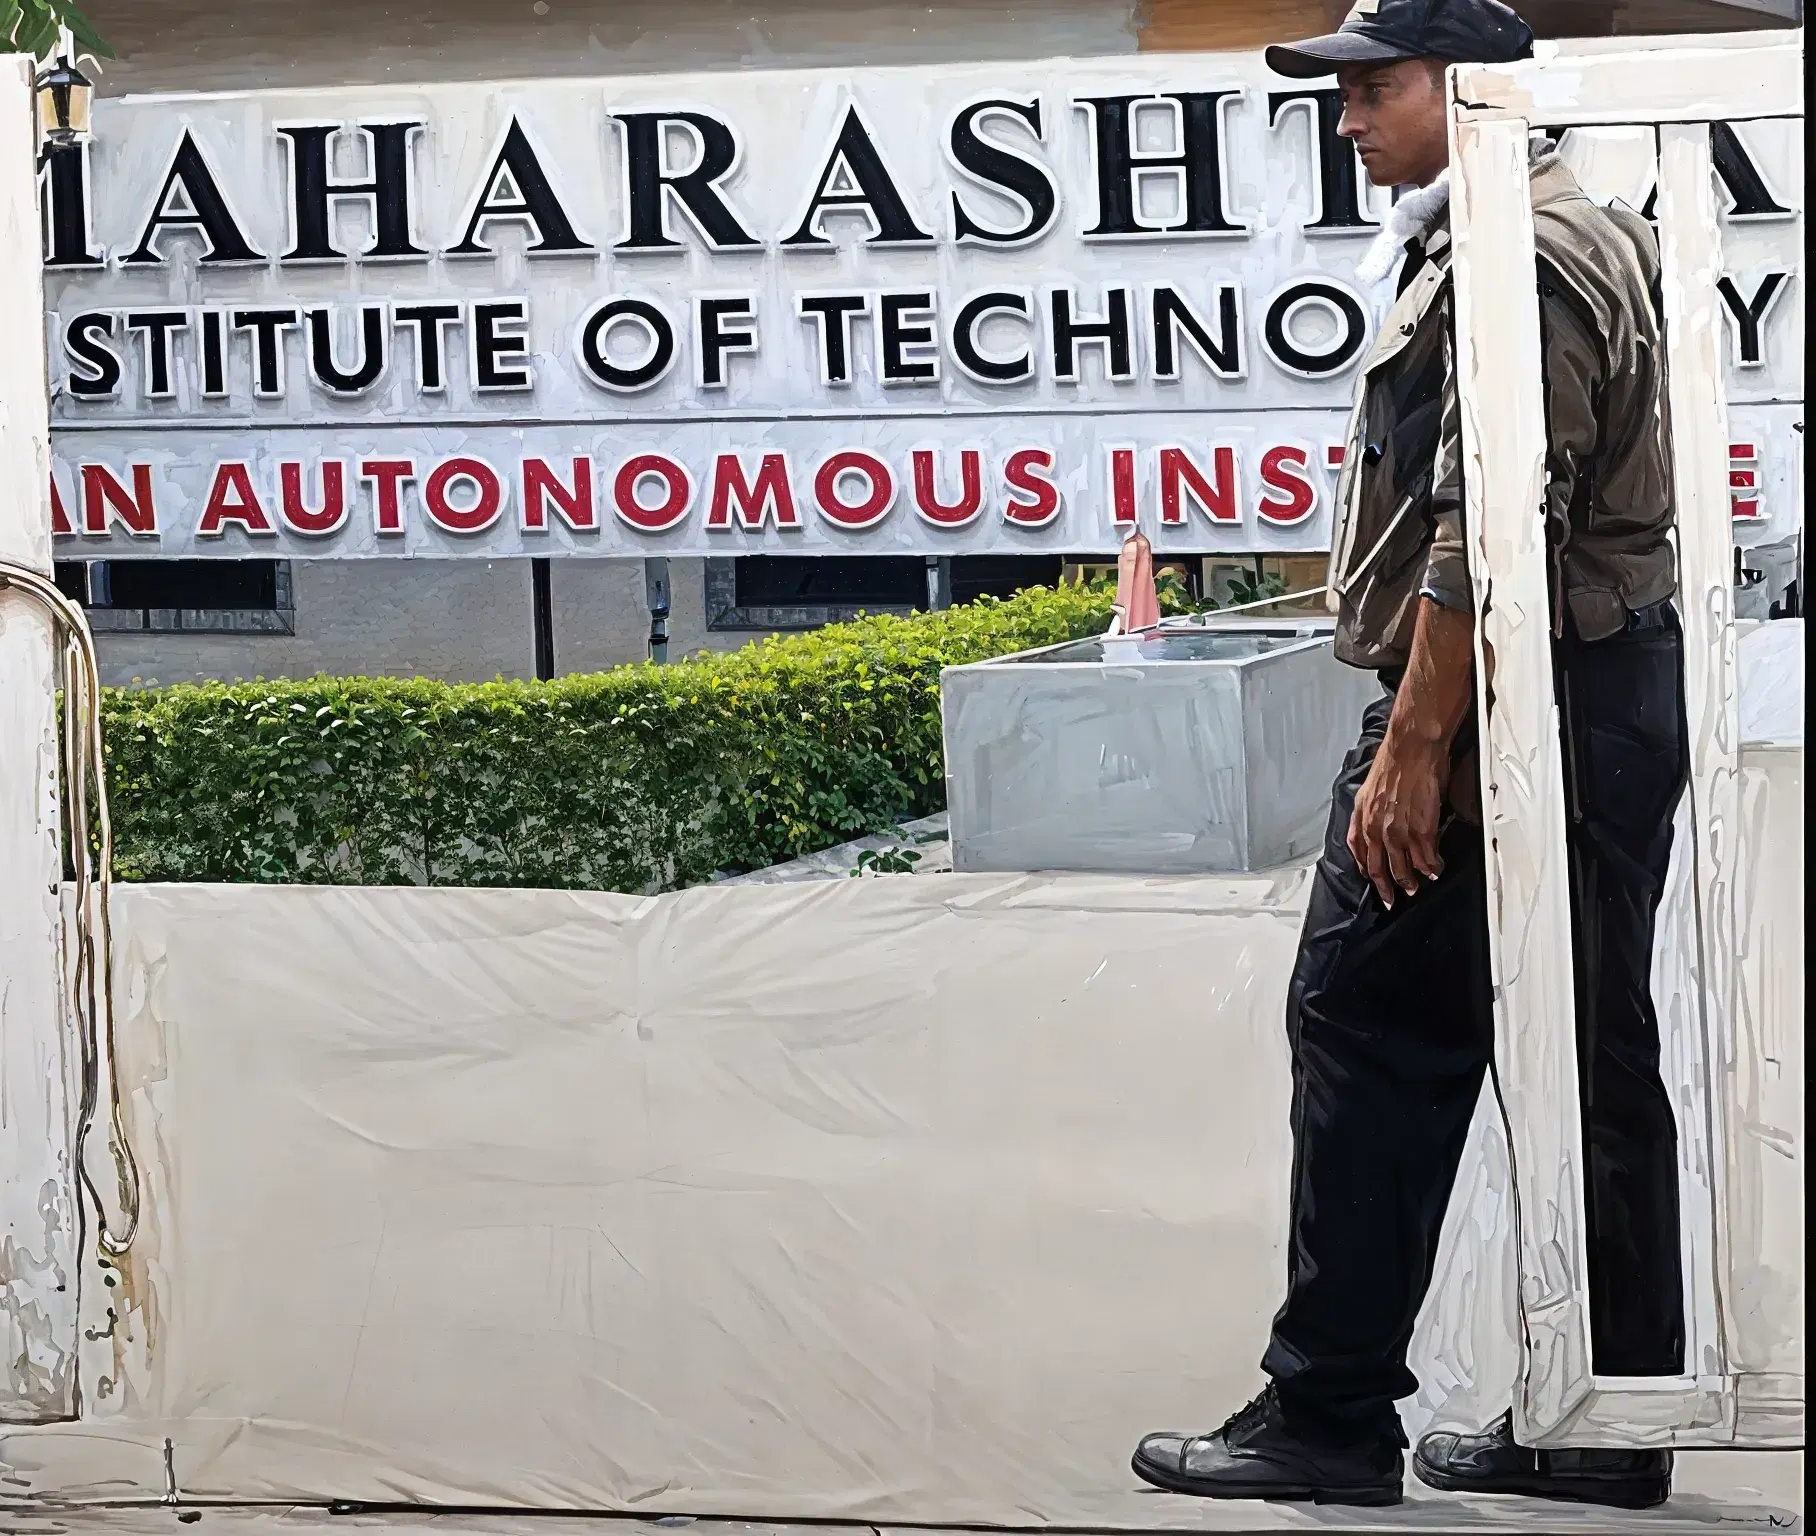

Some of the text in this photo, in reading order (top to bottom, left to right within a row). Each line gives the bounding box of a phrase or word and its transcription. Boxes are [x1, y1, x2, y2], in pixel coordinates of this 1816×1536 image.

[64, 304, 532, 396] STITUTE
[581, 298, 758, 392] OF
[52, 463, 156, 537] N
[197, 449, 1060, 536] AUTONOMOUS
